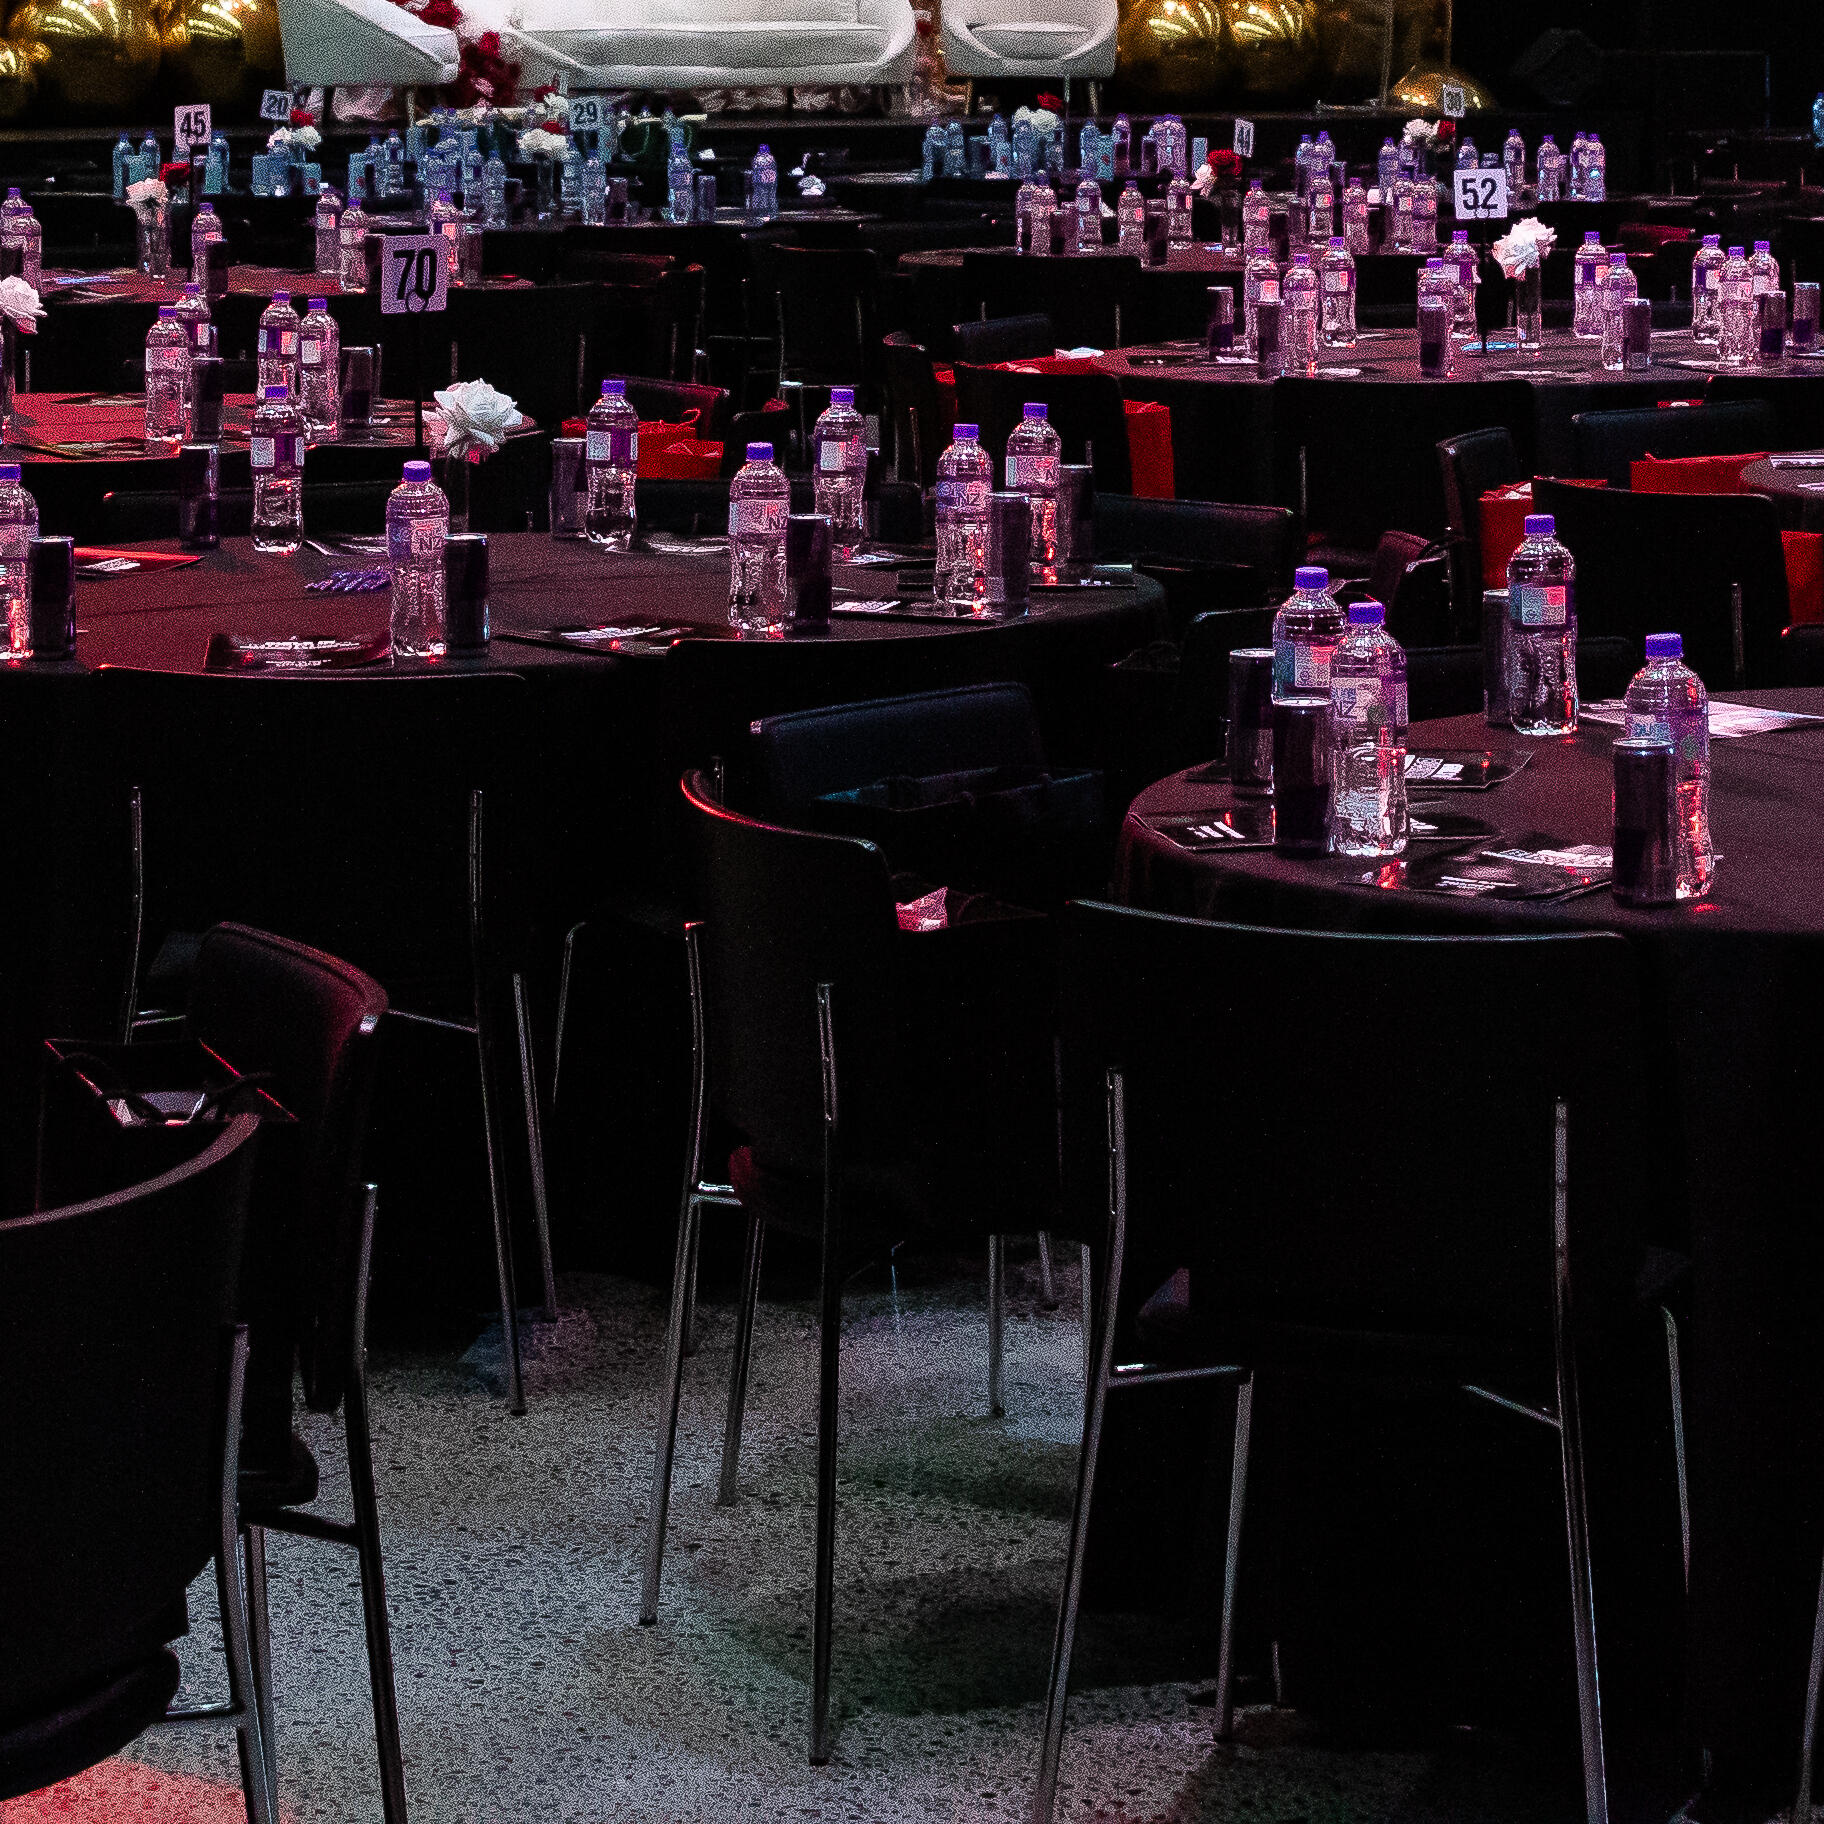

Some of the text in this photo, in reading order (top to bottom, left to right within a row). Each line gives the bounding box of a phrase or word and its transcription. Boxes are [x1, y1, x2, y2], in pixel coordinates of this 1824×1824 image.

[266, 94, 288, 115] 20
[573, 100, 598, 125] 29
[180, 110, 206, 138] 45
[1461, 177, 1498, 211] 52
[393, 247, 437, 300] 70
